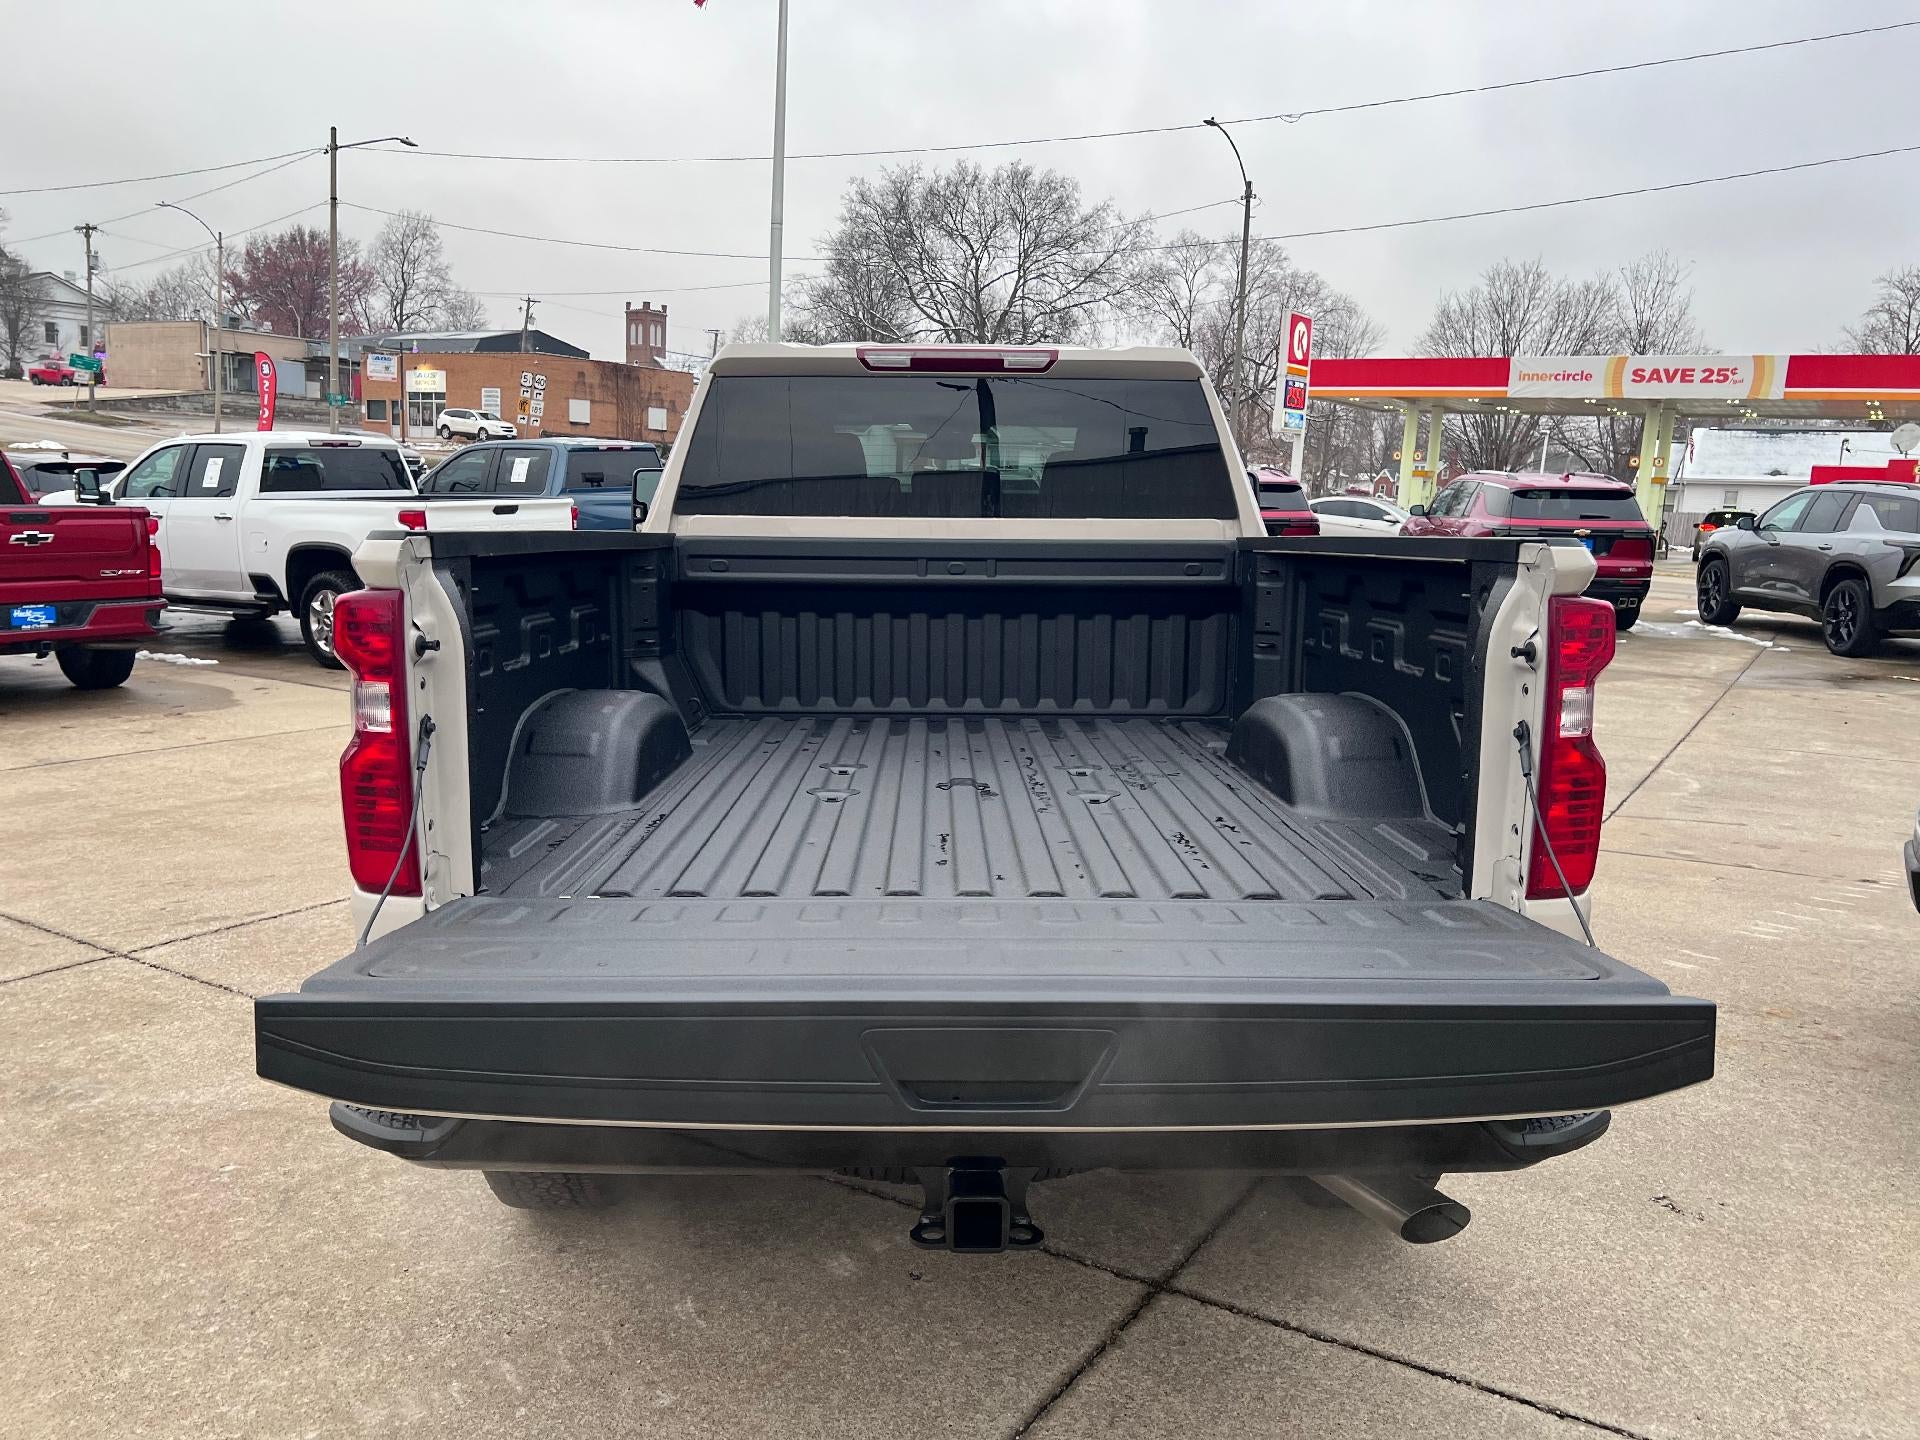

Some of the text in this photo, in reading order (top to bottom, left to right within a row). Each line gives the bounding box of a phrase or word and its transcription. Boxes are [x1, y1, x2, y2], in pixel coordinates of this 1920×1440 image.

[522, 374, 531, 384] 51
[1519, 370, 1593, 382] innercircle
[1631, 367, 1696, 384] SAVE
[1699, 367, 1738, 384] 25¢
[535, 377, 545, 387] 40
[531, 405, 542, 414] 185
